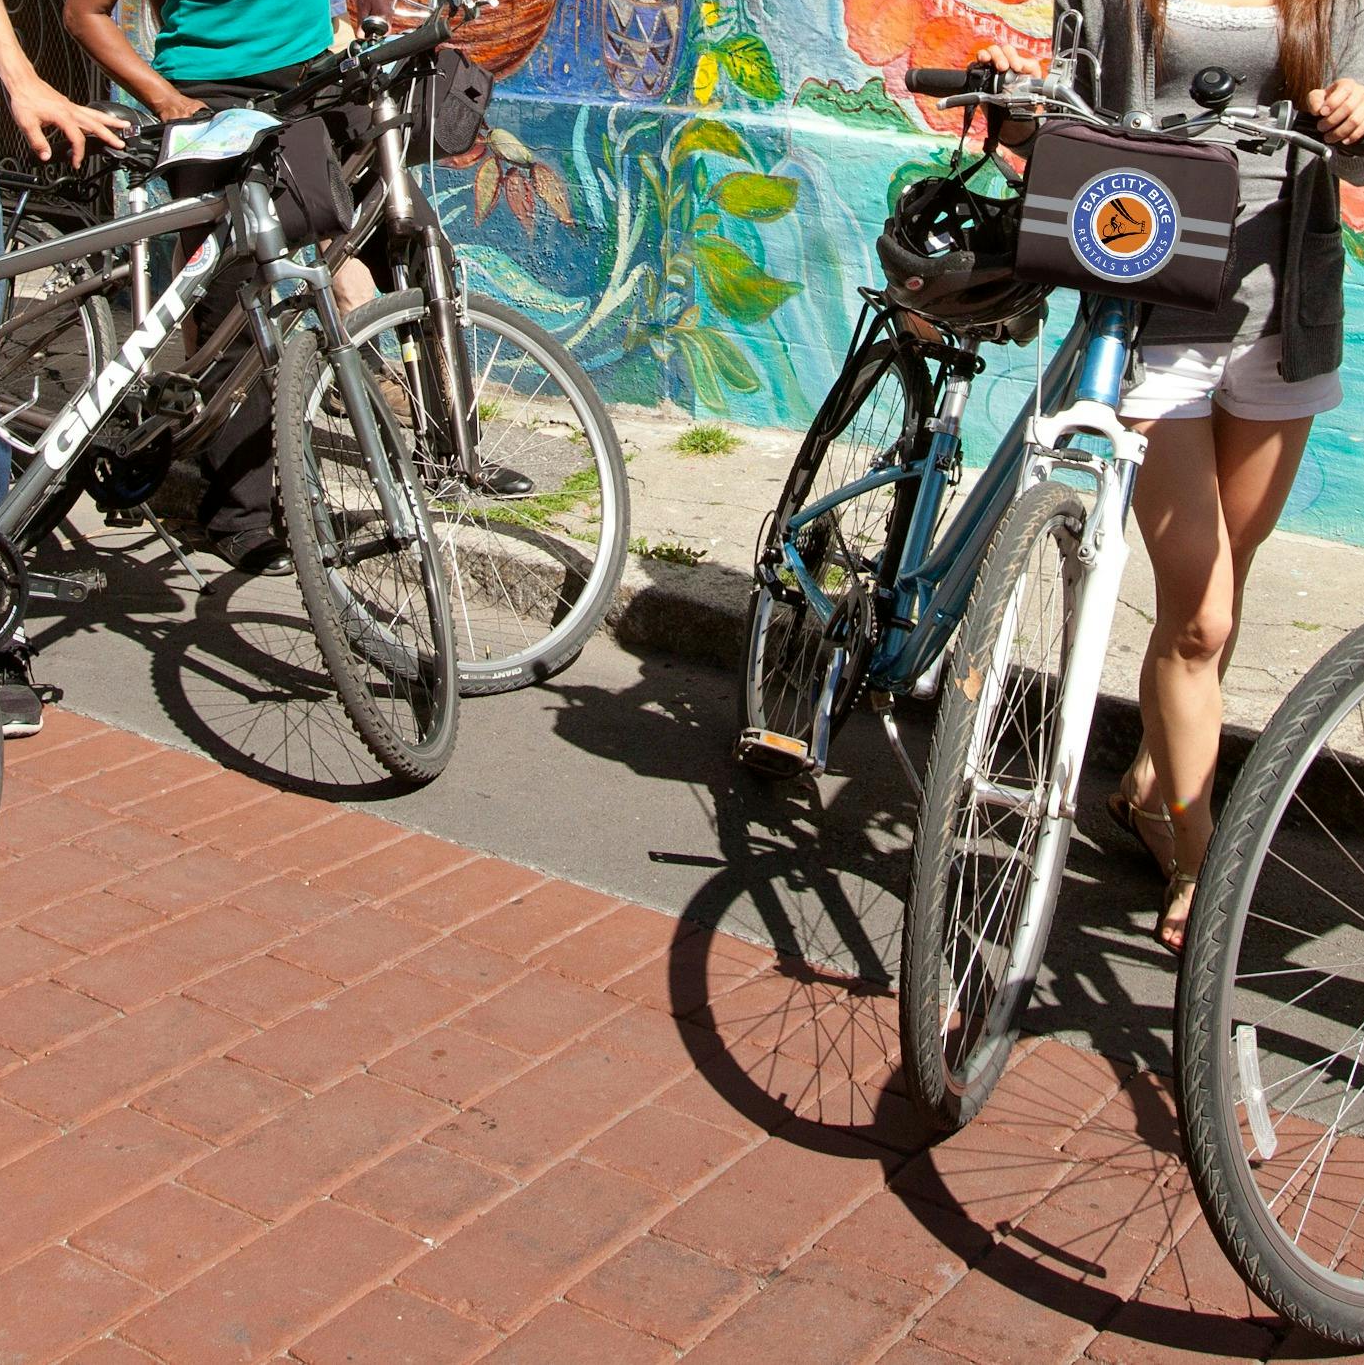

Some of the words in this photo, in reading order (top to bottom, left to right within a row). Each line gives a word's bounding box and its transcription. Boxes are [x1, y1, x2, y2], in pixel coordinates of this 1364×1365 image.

[1081, 183, 1106, 212] BAY
[1111, 178, 1147, 191] CITY
[1147, 189, 1171, 224] BIKE
[1078, 228, 1116, 271] RENTALS
[1135, 239, 1168, 270] TOURS
[45, 272, 186, 470] GIANT
[936, 455, 951, 467] XS
[492, 667, 523, 679] GIANT
